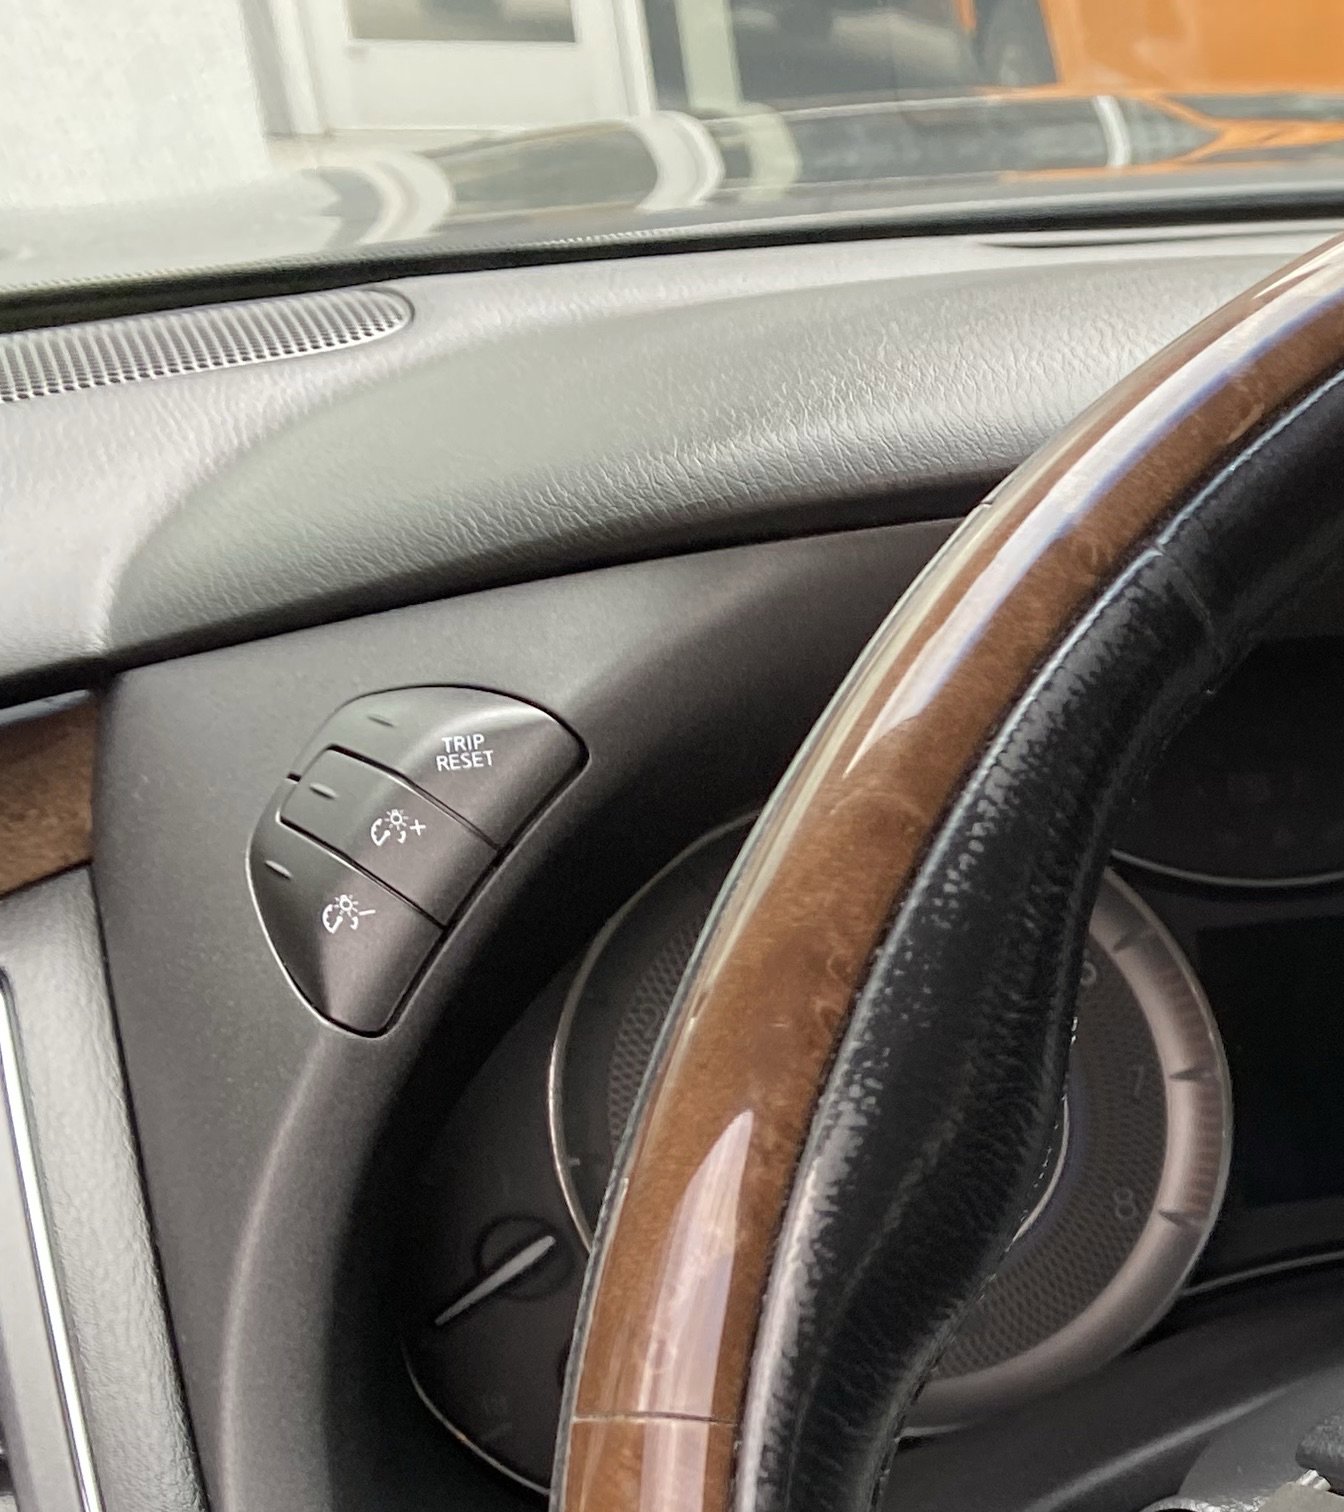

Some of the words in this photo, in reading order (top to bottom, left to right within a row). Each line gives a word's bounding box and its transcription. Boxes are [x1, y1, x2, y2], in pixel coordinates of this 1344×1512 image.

[441, 734, 486, 752] TRIP
[435, 750, 494, 772] RESET
[1114, 1187, 1138, 1222] 8
